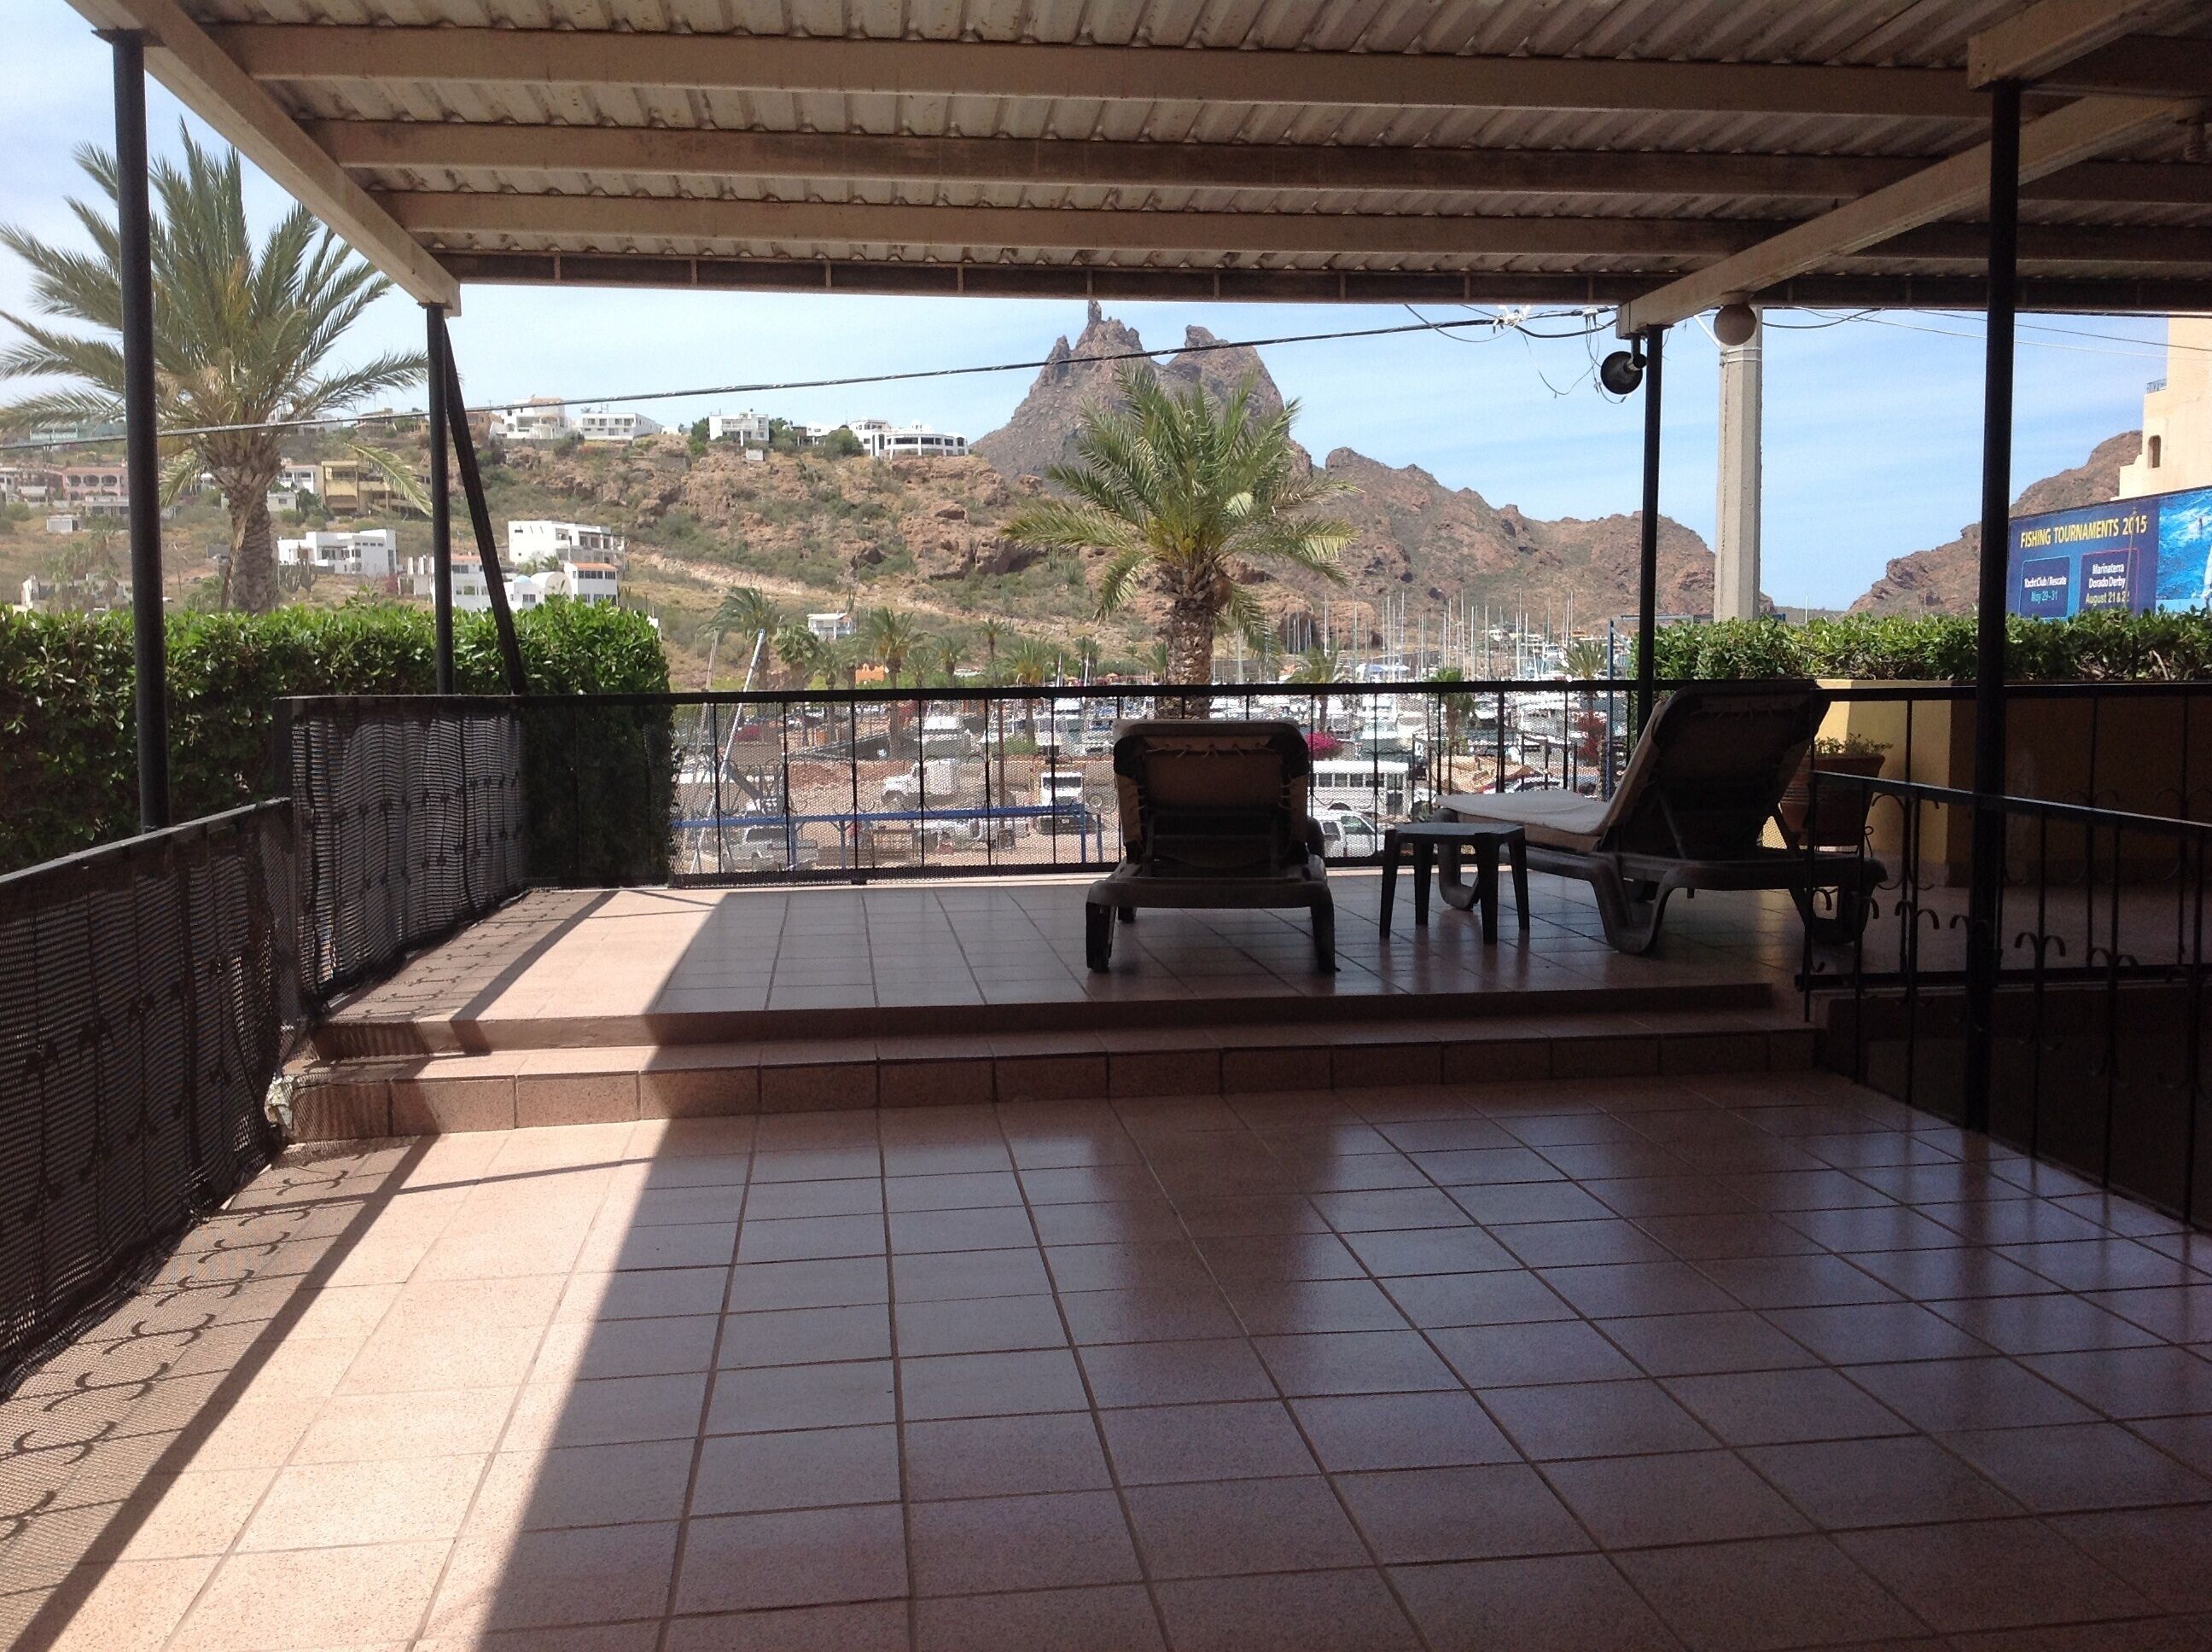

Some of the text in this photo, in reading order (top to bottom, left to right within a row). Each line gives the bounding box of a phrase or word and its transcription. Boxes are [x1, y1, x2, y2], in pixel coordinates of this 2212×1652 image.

[2020, 515, 2147, 549] FISHING TOURNAMENTS 2015
[2088, 575, 2126, 589] Dorado Derby
[2085, 592, 2107, 607] August
